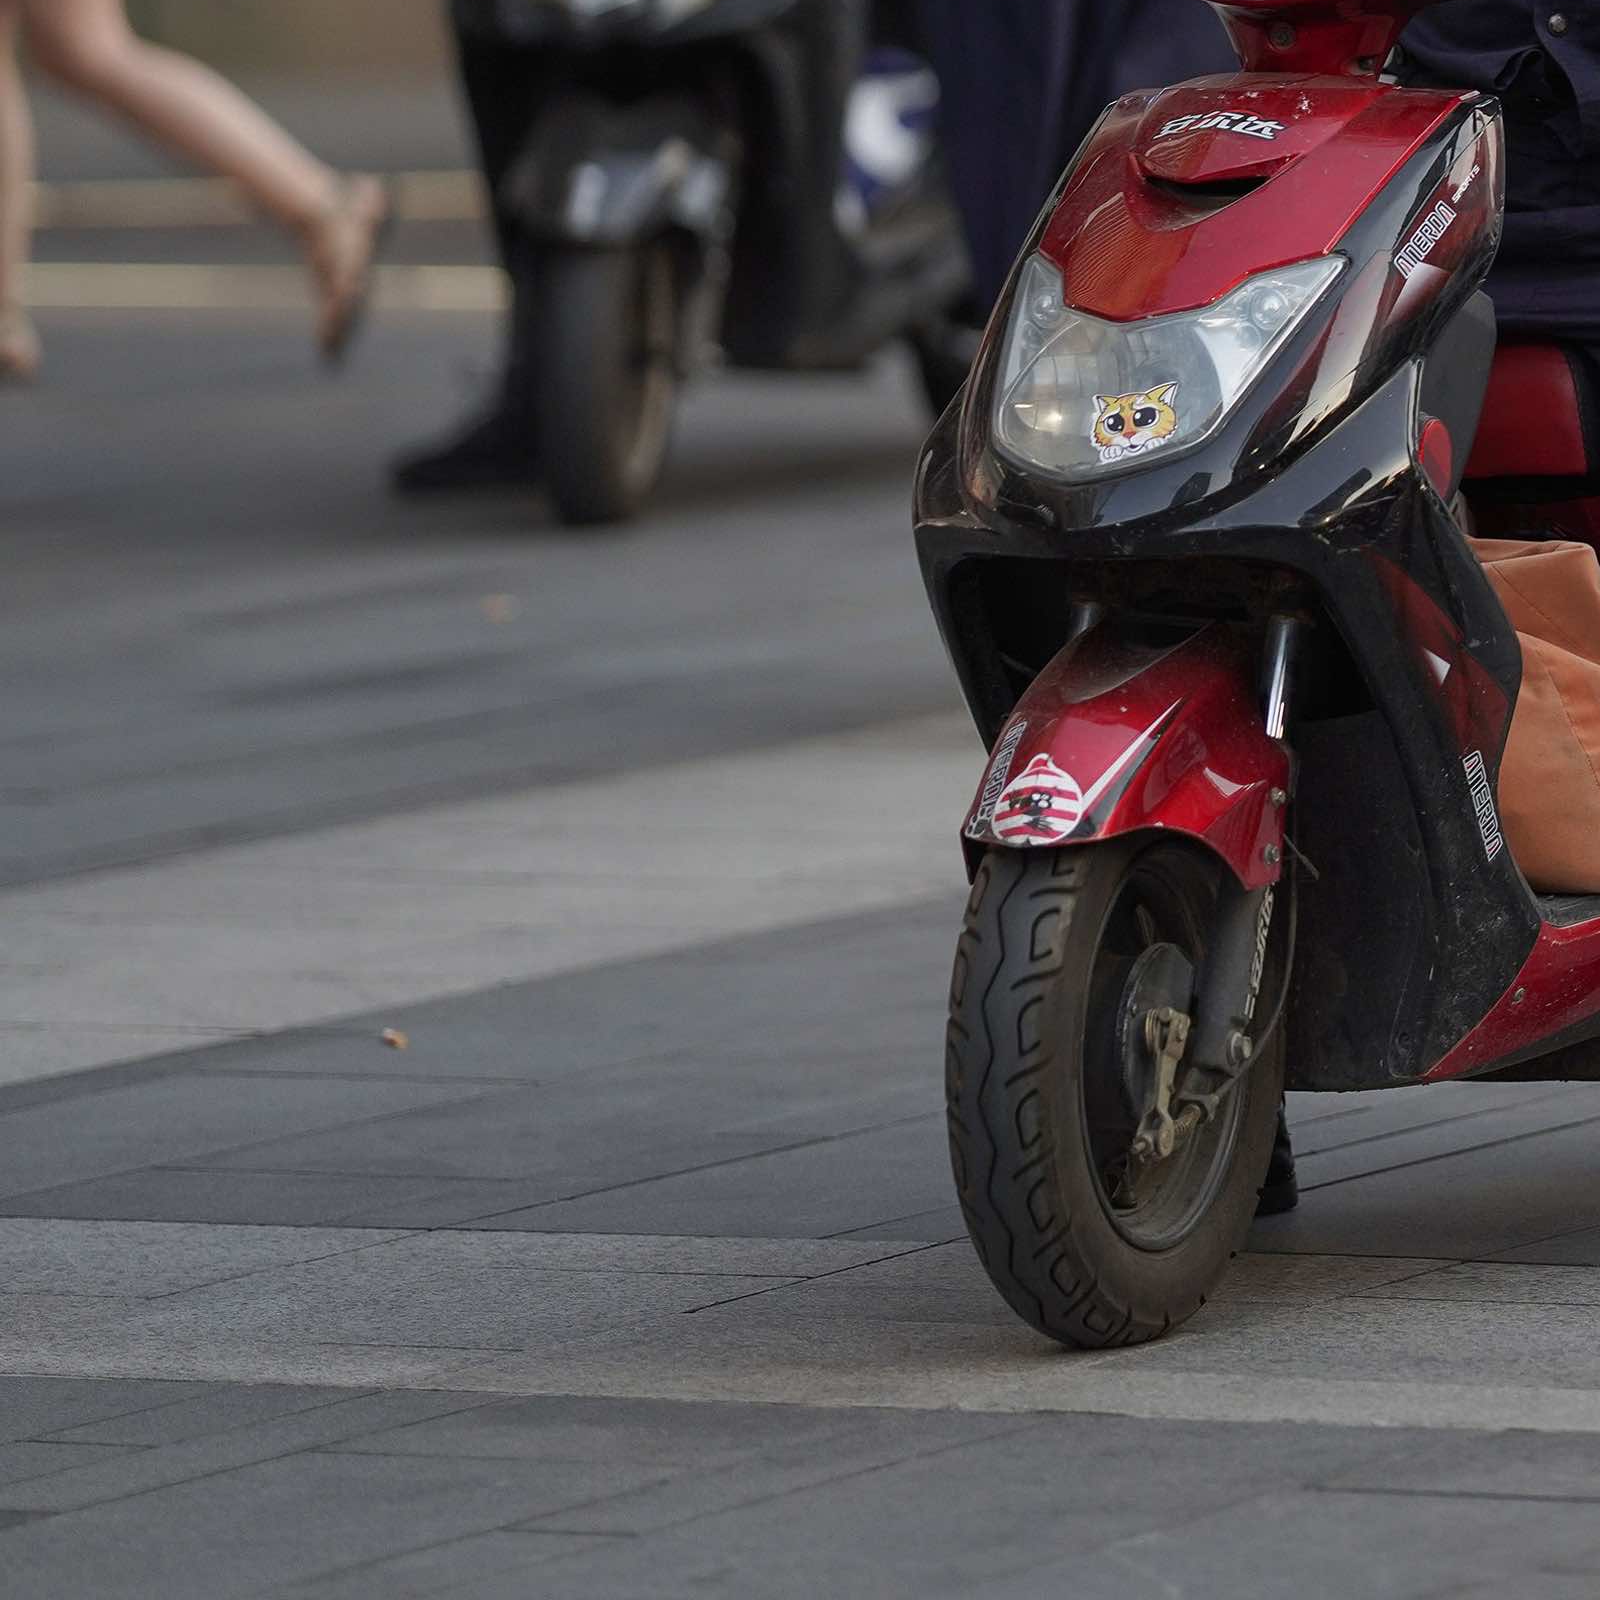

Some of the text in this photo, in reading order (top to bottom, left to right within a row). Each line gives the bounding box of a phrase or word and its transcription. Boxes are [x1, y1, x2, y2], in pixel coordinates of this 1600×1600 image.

[1152, 110, 1286, 140] 安尔达
[1393, 163, 1480, 280] ANERDA SPORTS
[1462, 749, 1504, 862] ANERDA
